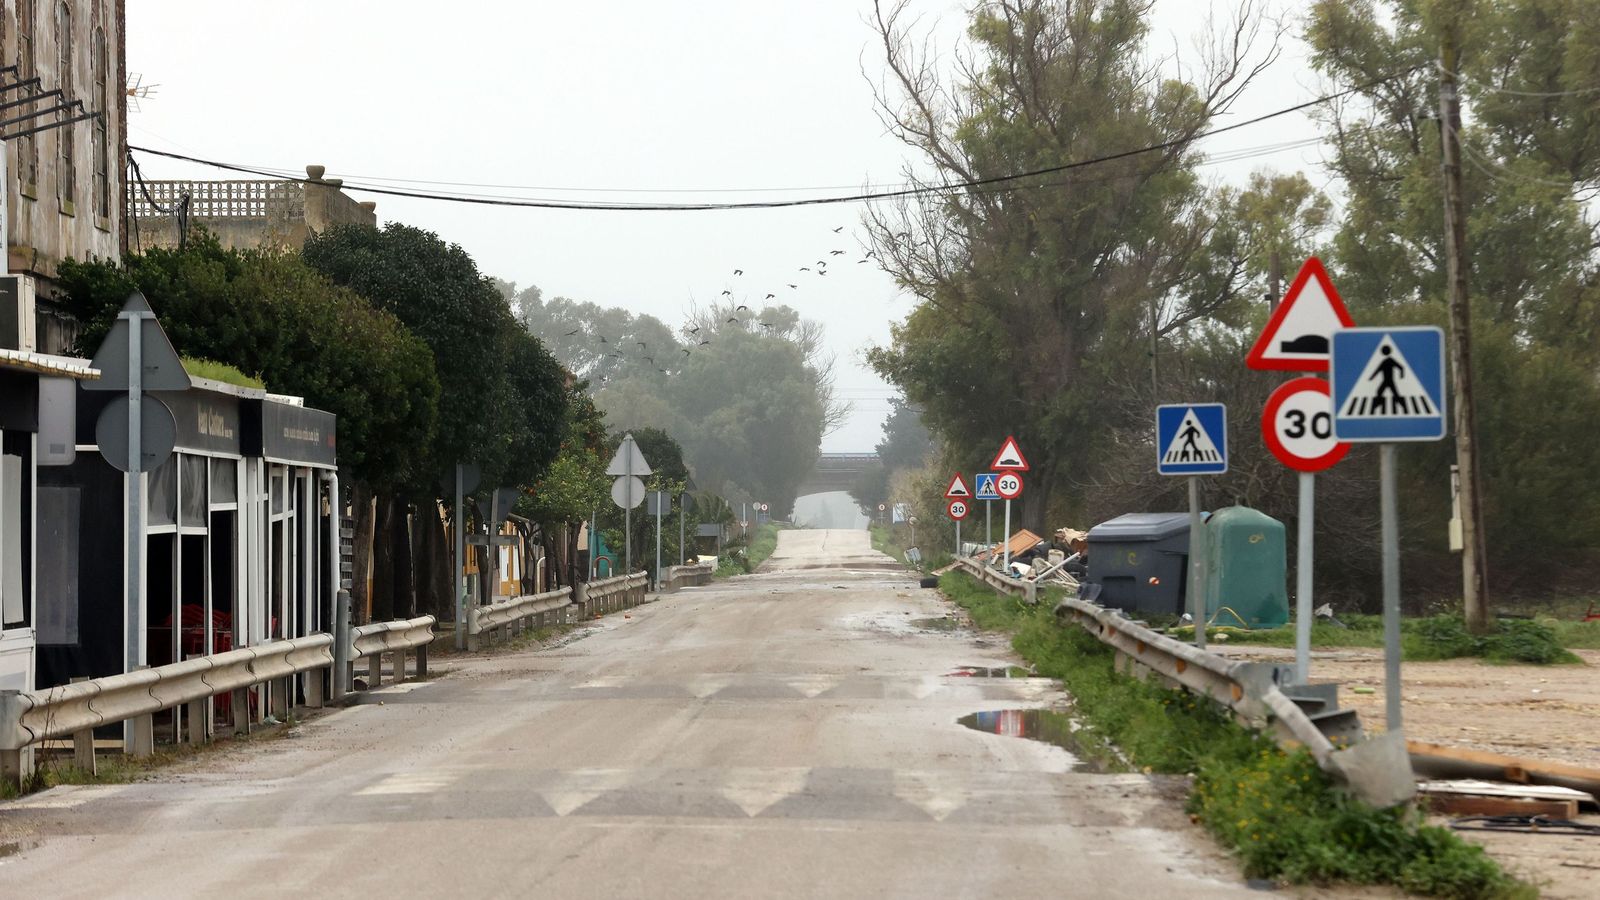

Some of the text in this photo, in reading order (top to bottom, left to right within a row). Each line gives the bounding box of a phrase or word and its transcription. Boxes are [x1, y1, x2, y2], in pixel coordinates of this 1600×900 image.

[1284, 409, 1332, 440] 30
[1001, 480, 1017, 490] 30
[952, 505, 965, 514] 30
